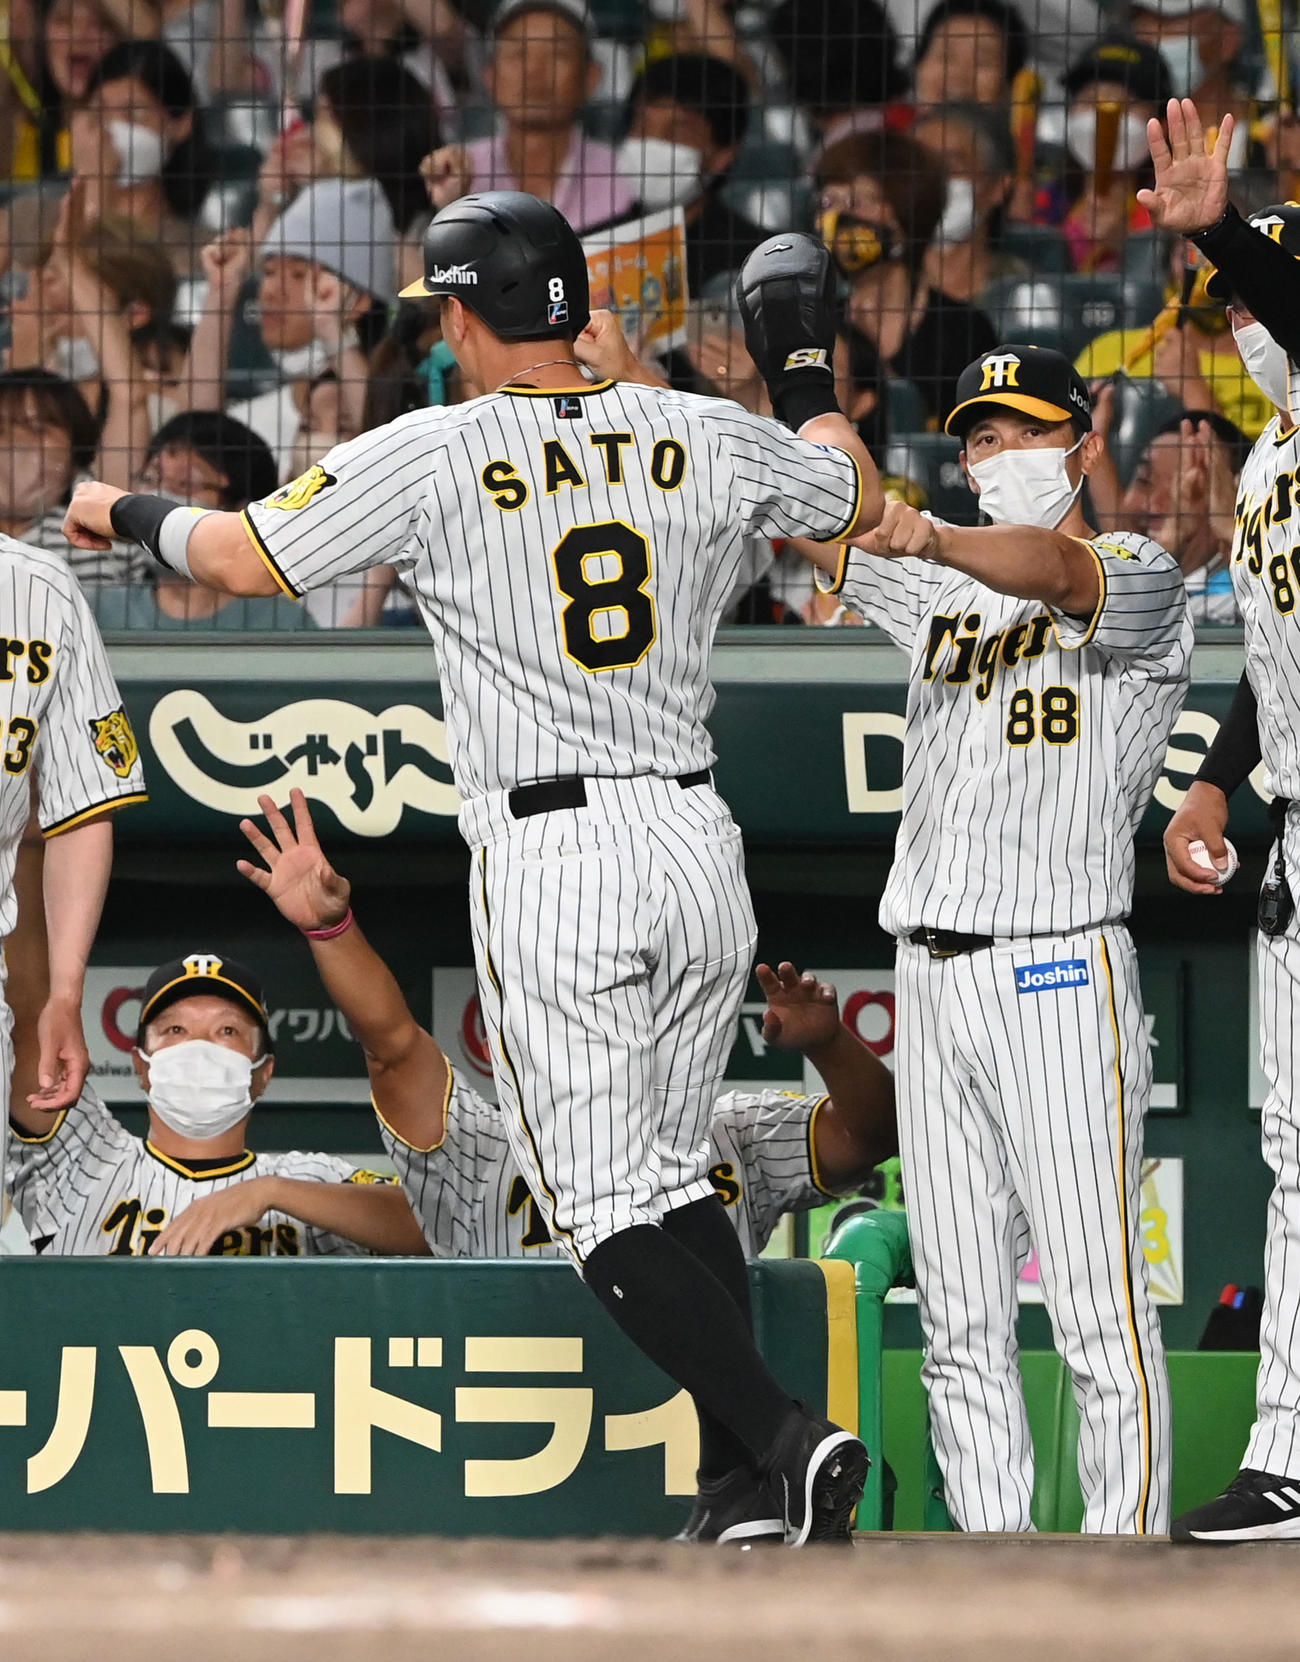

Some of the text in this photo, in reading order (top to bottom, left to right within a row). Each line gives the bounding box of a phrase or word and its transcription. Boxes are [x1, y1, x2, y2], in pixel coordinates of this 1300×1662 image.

[429, 263, 478, 285] Joshin
[548, 277, 564, 302] 8
[482, 432, 687, 512] SATO
[553, 519, 657, 673] 8
[1006, 685, 1080, 747] 88
[171, 716, 456, 812] じゃらん
[1018, 964, 1088, 989] Joshin
[102, 1198, 299, 1255] Tiers
[0, 1328, 700, 1497] パードライ
